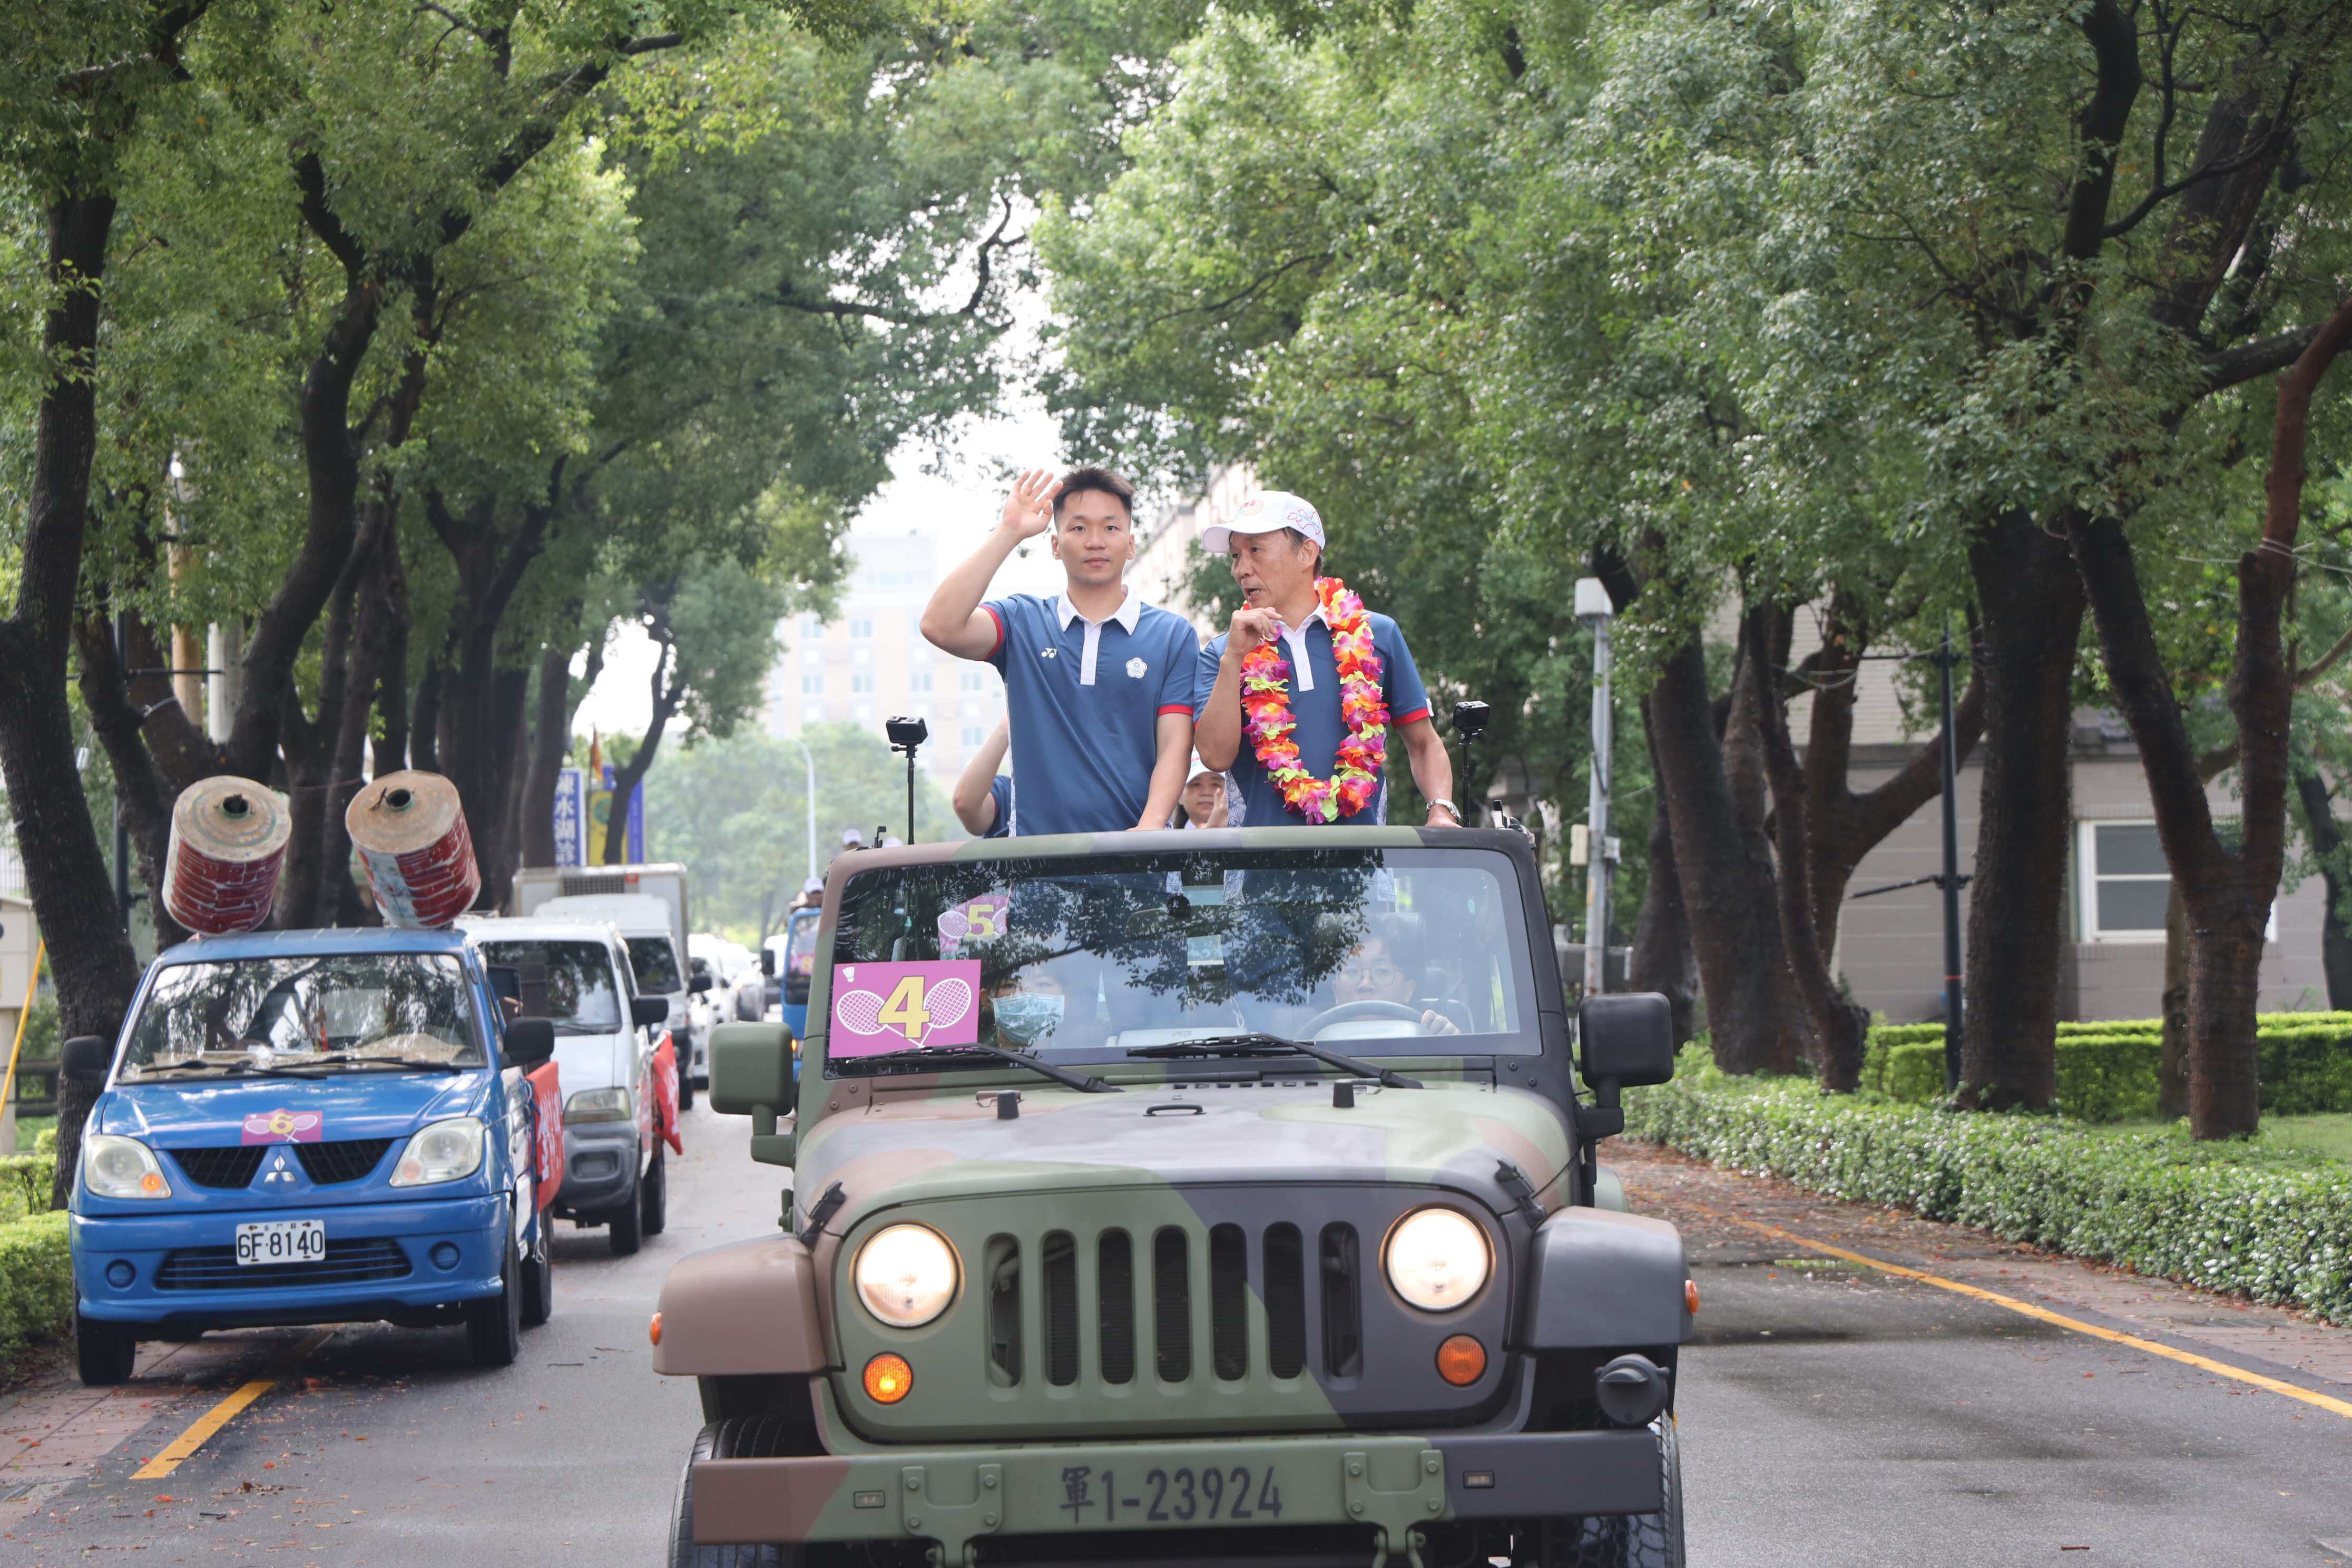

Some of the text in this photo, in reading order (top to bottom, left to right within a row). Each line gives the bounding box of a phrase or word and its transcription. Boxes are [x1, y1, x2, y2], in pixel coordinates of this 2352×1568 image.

[965, 904, 995, 938] 5
[877, 976, 930, 1038] 4
[269, 1112, 295, 1134] 6
